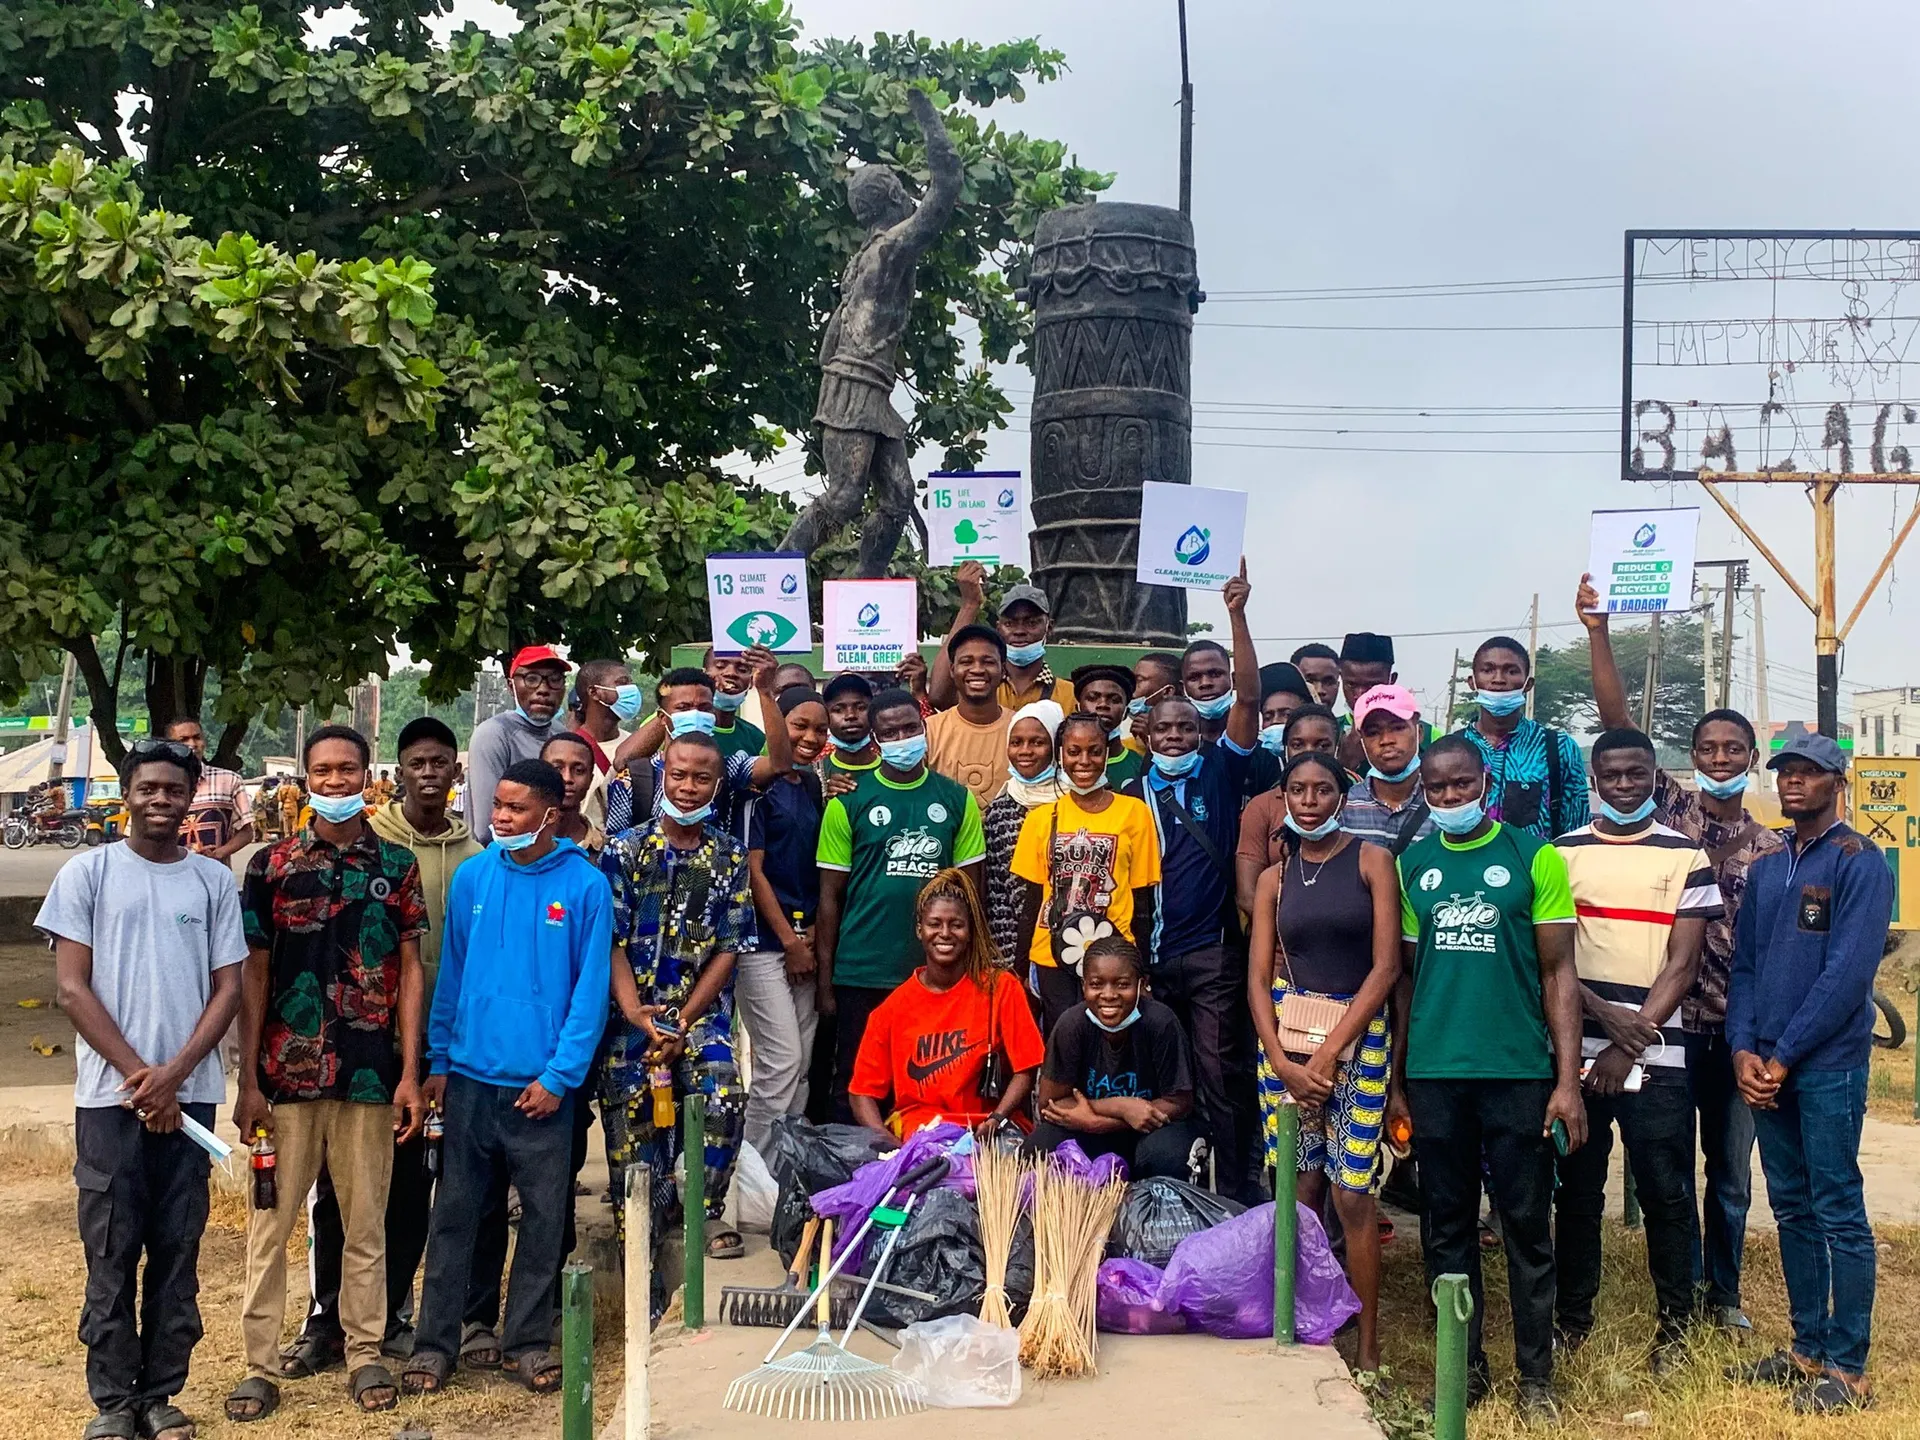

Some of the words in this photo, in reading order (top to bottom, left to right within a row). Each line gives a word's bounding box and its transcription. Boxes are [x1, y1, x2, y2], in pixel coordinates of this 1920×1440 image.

[1639, 237, 1796, 280] MERRY
[1656, 319, 1773, 365] HAPPY
[933, 489, 952, 508] 15
[957, 489, 970, 497] LIFE
[957, 500, 967, 508] ON
[969, 500, 986, 509] LAND
[1617, 563, 1656, 572] REDUCE
[739, 573, 767, 583] CLIMATE
[1154, 568, 1192, 577] CLEAN-UP
[1193, 571, 1230, 581] BADAGRY
[1616, 574, 1656, 582] REUSE
[713, 574, 734, 595] 13
[1171, 577, 1212, 586] INITIATIVE
[740, 586, 765, 595] ACTION
[1614, 585, 1657, 594] RECYCLE
[1607, 598, 1618, 612] IN
[1620, 597, 1668, 612] BADAGRY
[837, 651, 870, 665] CLEAN,
[872, 651, 903, 664] GREEN
[1861, 770, 1901, 778] NIGERIAN
[1868, 804, 1898, 812] LEGION
[889, 837, 938, 859] Ride
[886, 860, 939, 874] PEACE
[1437, 904, 1495, 928] Ride
[1460, 924, 1476, 933] for
[1435, 931, 1496, 948] PEACE
[916, 1029, 968, 1059] NIKE
